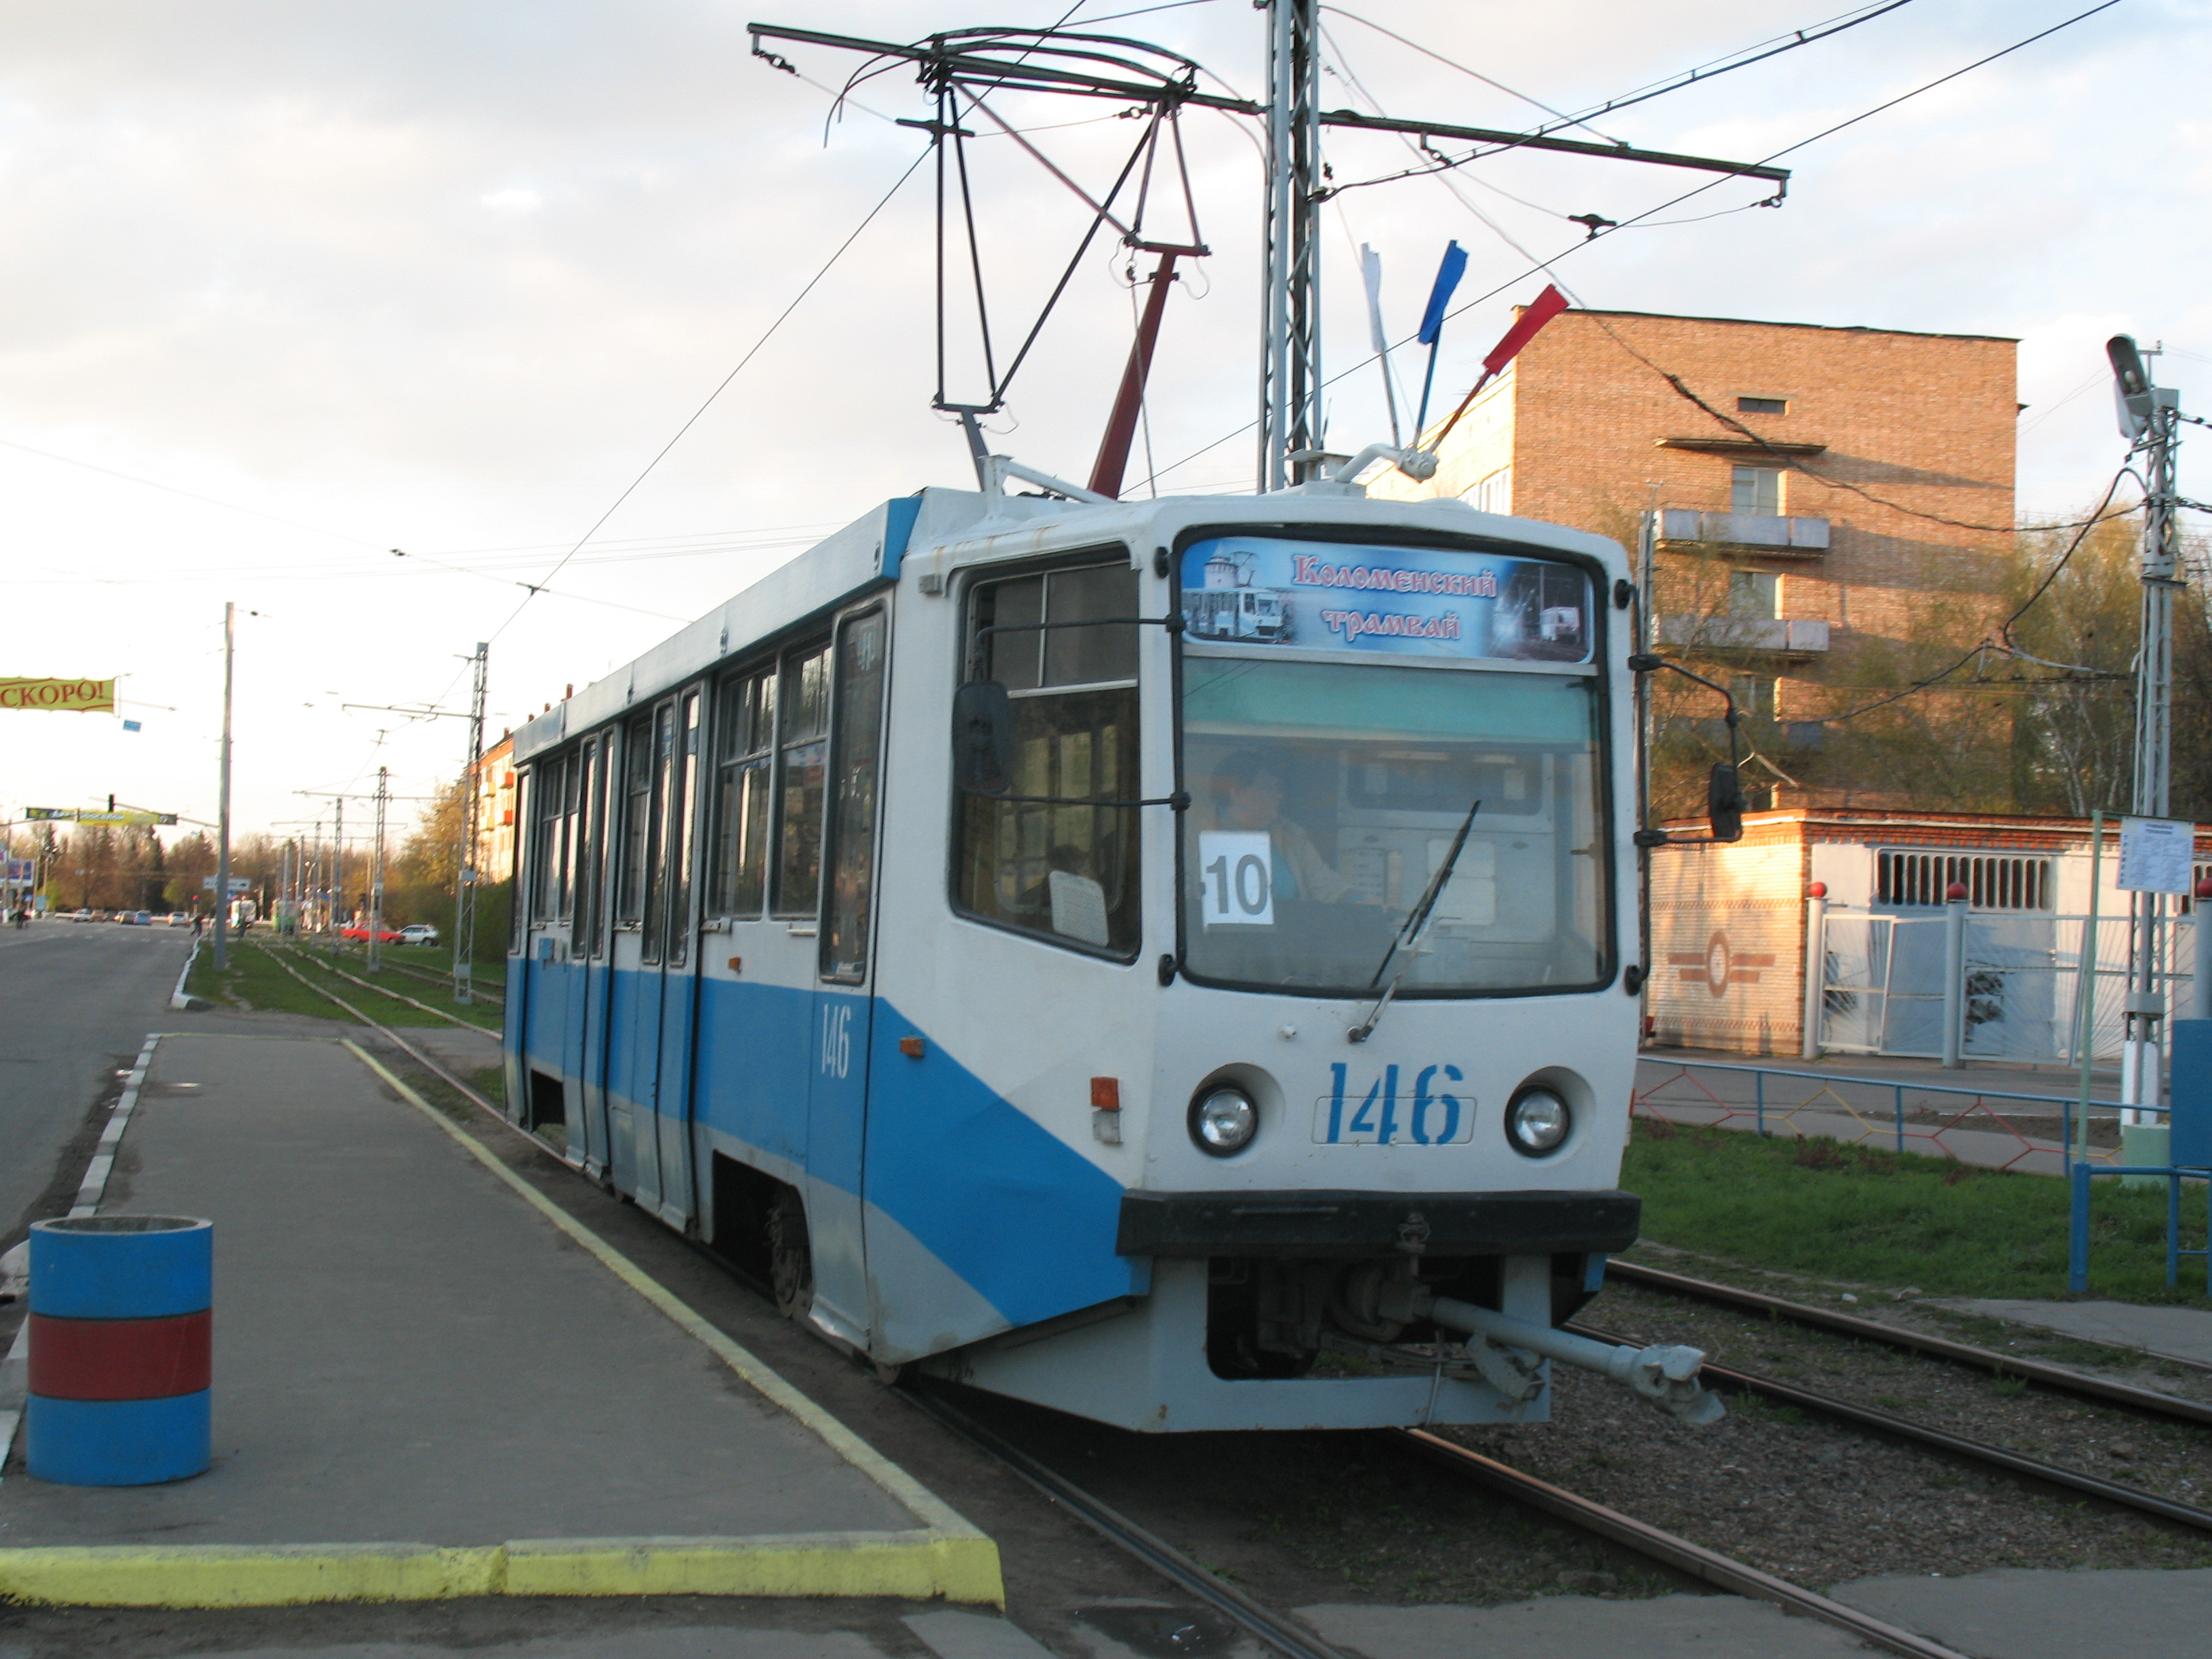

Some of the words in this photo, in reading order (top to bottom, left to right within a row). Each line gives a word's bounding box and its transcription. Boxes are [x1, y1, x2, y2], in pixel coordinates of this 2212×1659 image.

[1292, 554, 1498, 598] Коломенский
[1322, 610, 1460, 642] трамвай
[0, 680, 104, 708] СКОРО!
[1206, 854, 1269, 916] 10
[821, 1003, 852, 1080] 146
[1326, 1062, 1464, 1147] 146
